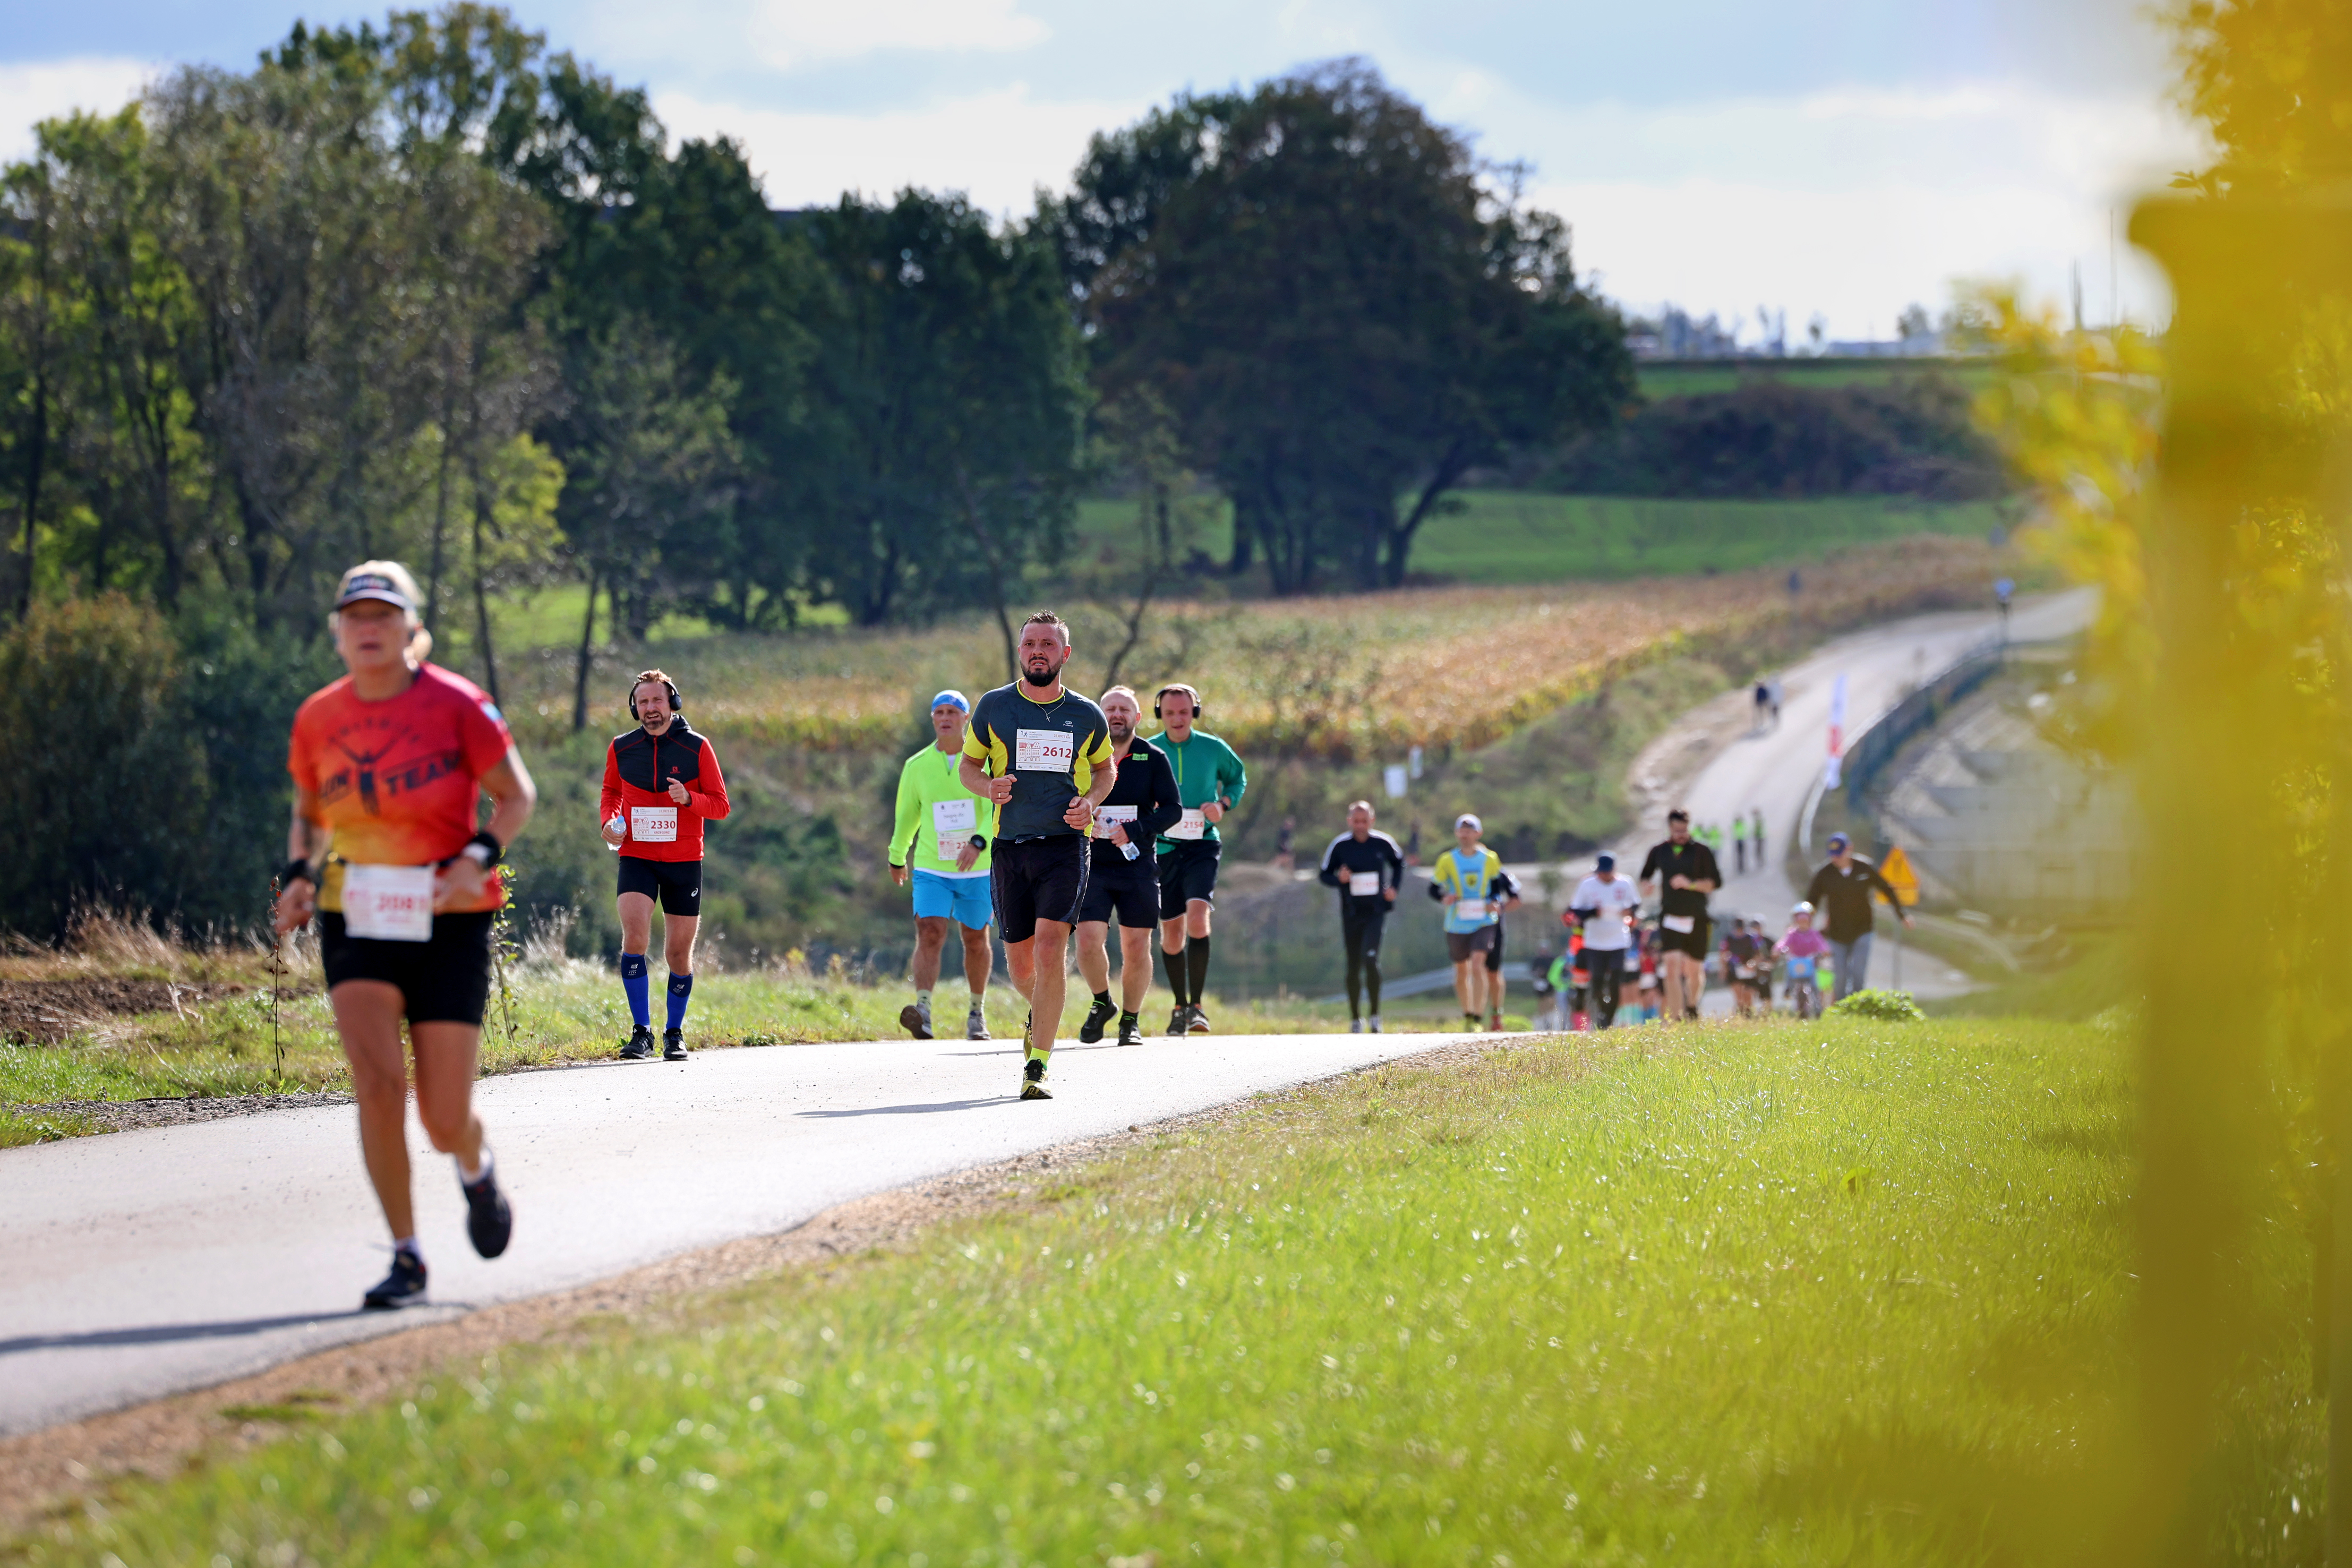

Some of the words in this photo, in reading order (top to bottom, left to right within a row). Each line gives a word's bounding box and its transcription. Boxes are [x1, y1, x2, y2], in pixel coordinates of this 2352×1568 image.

[1042, 746, 1072, 758] 2612
[385, 749, 462, 798] TEAM
[651, 820, 675, 829] 2330
